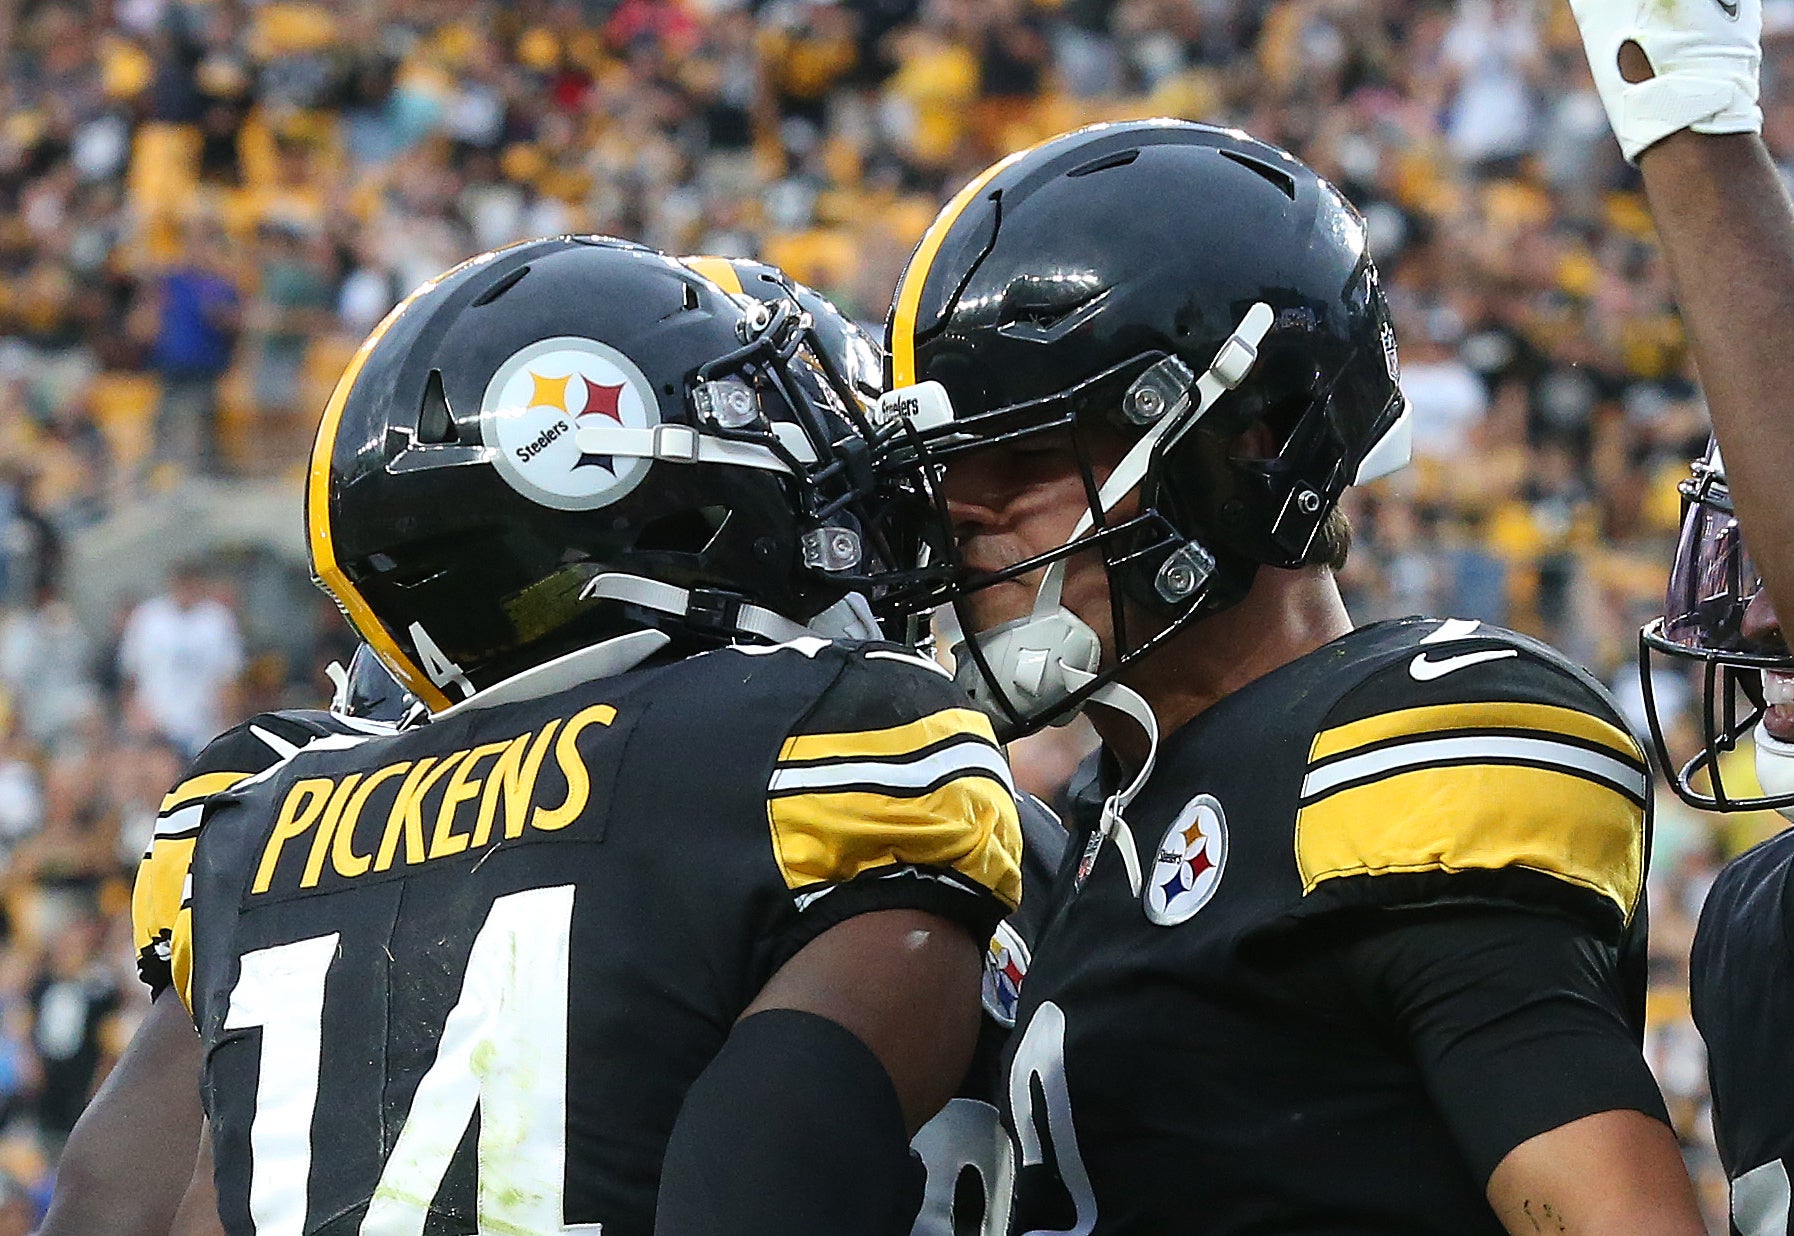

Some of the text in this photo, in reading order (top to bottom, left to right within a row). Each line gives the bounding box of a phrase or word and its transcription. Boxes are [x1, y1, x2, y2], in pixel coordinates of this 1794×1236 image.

[516, 420, 569, 463] Steelers
[408, 621, 477, 698] 4
[251, 704, 618, 894] PICKENS
[223, 884, 603, 1236] 14
